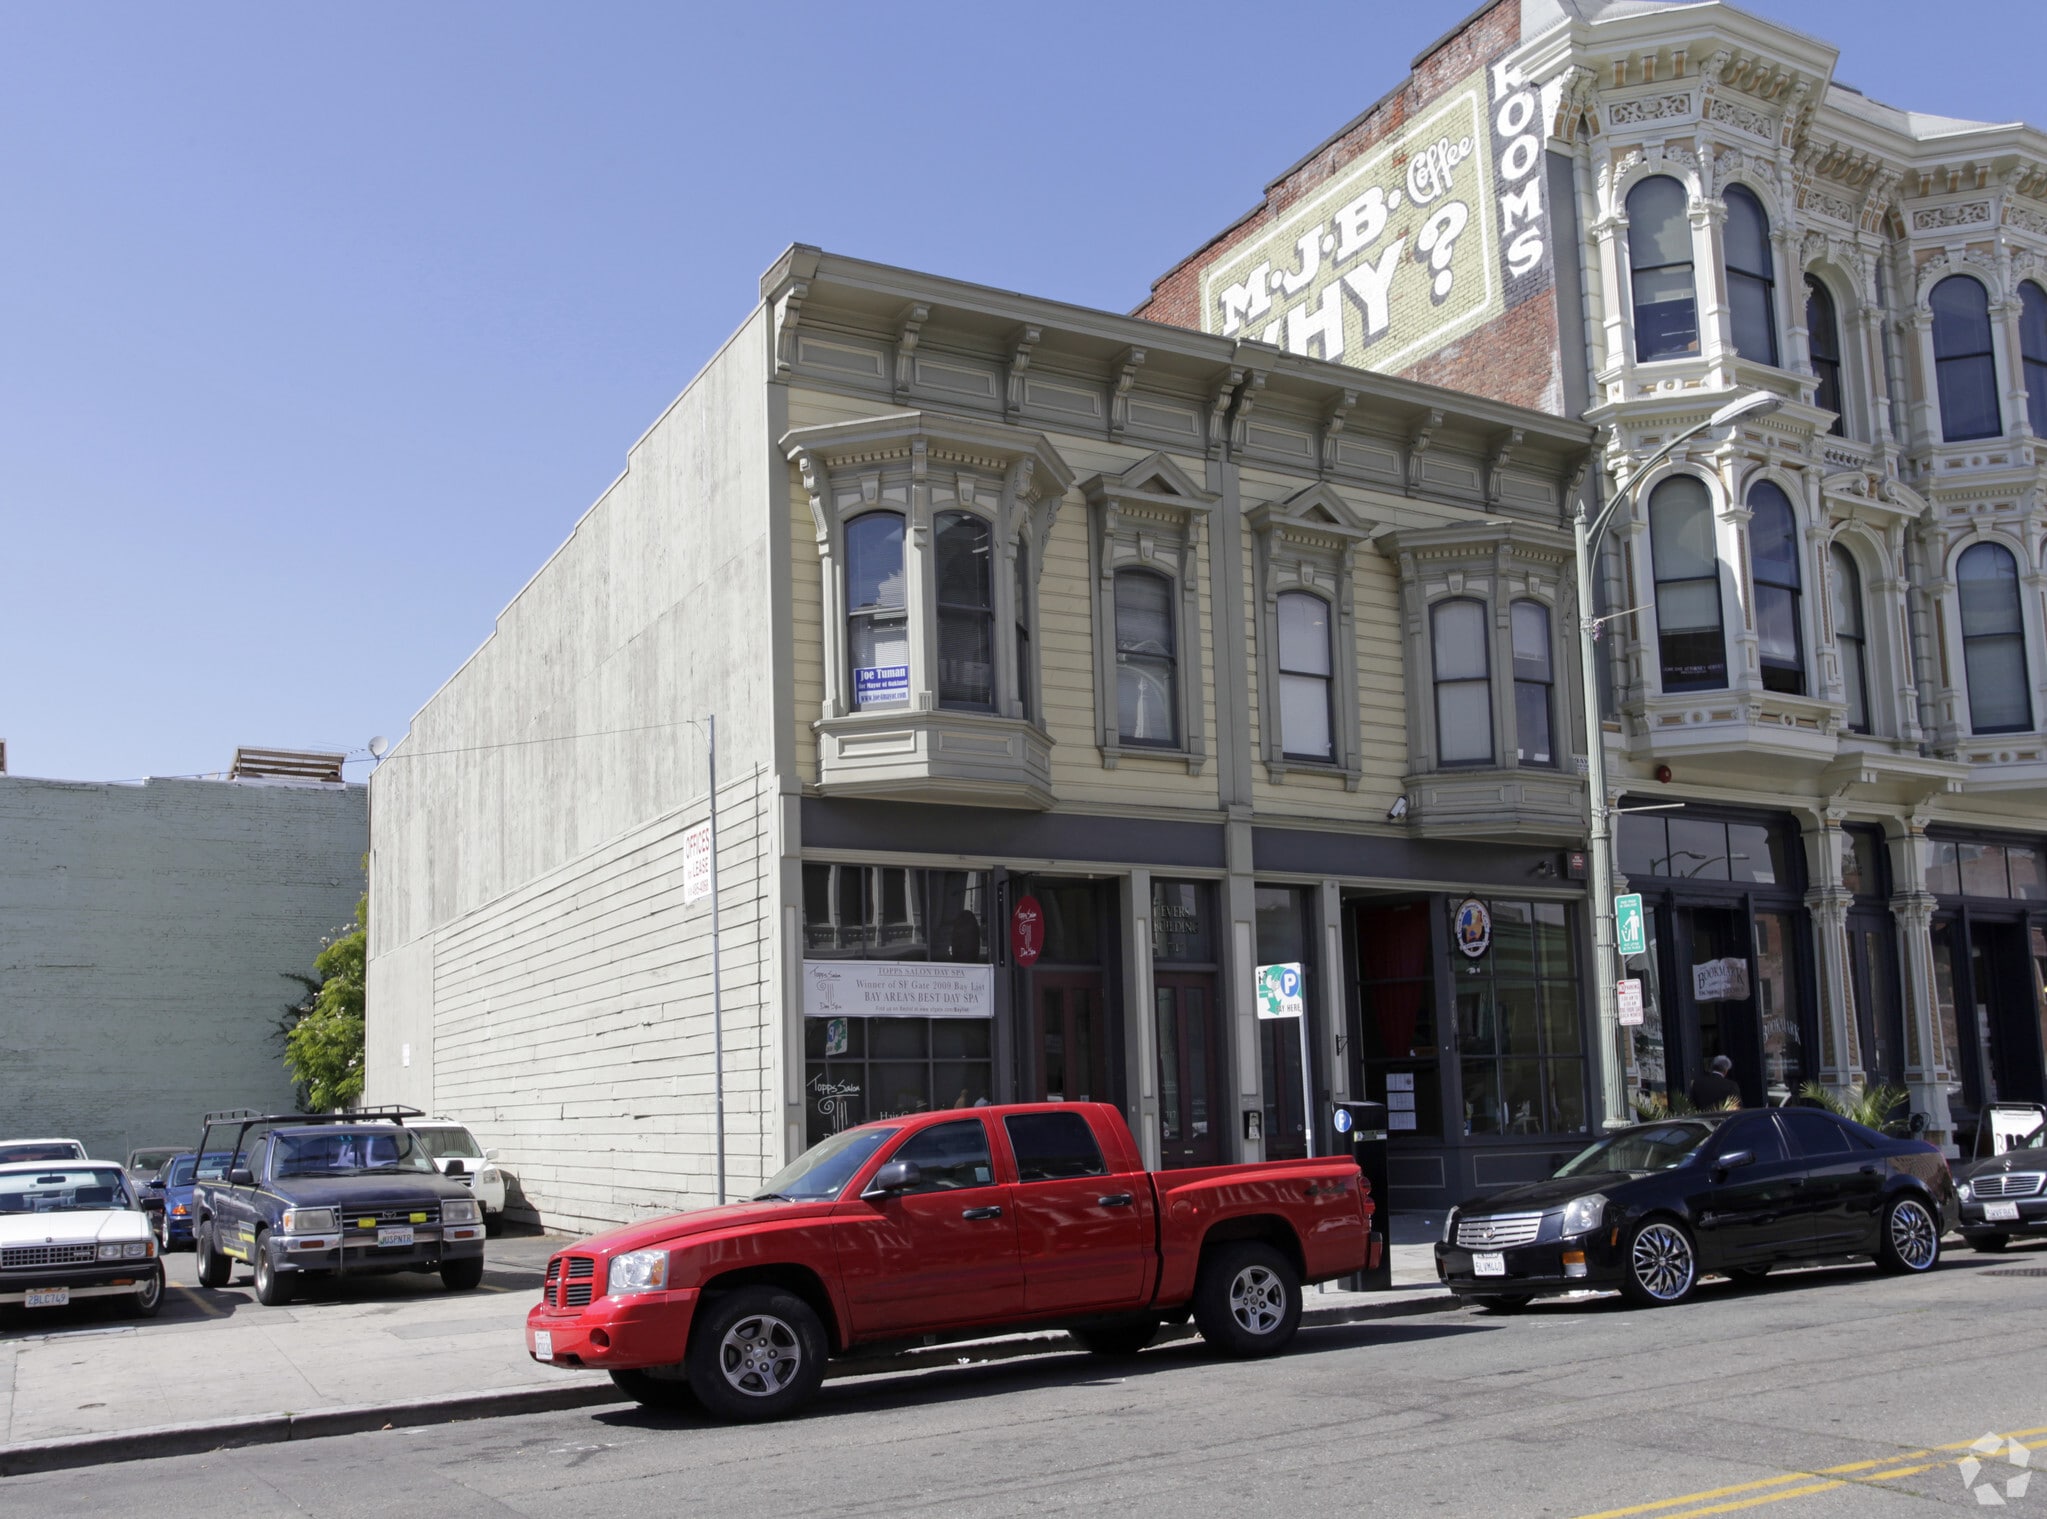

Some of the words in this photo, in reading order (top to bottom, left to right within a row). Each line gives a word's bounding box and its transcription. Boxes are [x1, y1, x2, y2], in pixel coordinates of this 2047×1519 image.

[1406, 134, 1474, 204] Coffee
[1491, 57, 1543, 278] ROOMS
[860, 670, 874, 682] Joe
[876, 668, 906, 679] Tuman
[686, 827, 710, 859] OFFICES
[693, 856, 709, 877] LEASE
[1154, 919, 1199, 933] BUILDING
[878, 967, 903, 976] TOPPS
[905, 968, 932, 976] SALON
[934, 968, 949, 976] DAY
[951, 968, 966, 977] SPA
[1697, 966, 1745, 990] BOOKMARK
[856, 979, 884, 989] Winner
[889, 979, 898, 989] of
[898, 980, 909, 989] SF
[911, 980, 930, 990] Gate
[933, 981, 952, 990] 2009
[954, 981, 968, 992] Bay
[864, 992, 882, 1002] BAY
[884, 992, 916, 1003] AREA'S
[918, 992, 941, 1003] BEST
[944, 993, 961, 1004] DAY
[963, 993, 979, 1004] SPA
[1287, 1003, 1302, 1012] HERE
[1763, 1017, 1802, 1046] BOOKMARK
[806, 1073, 838, 1094] Topps
[836, 1079, 860, 1094] Salon
[880, 1111, 899, 1121] Hair
[380, 1234, 412, 1245] JUSPNTR
[28, 1293, 66, 1305] 2BLC749
